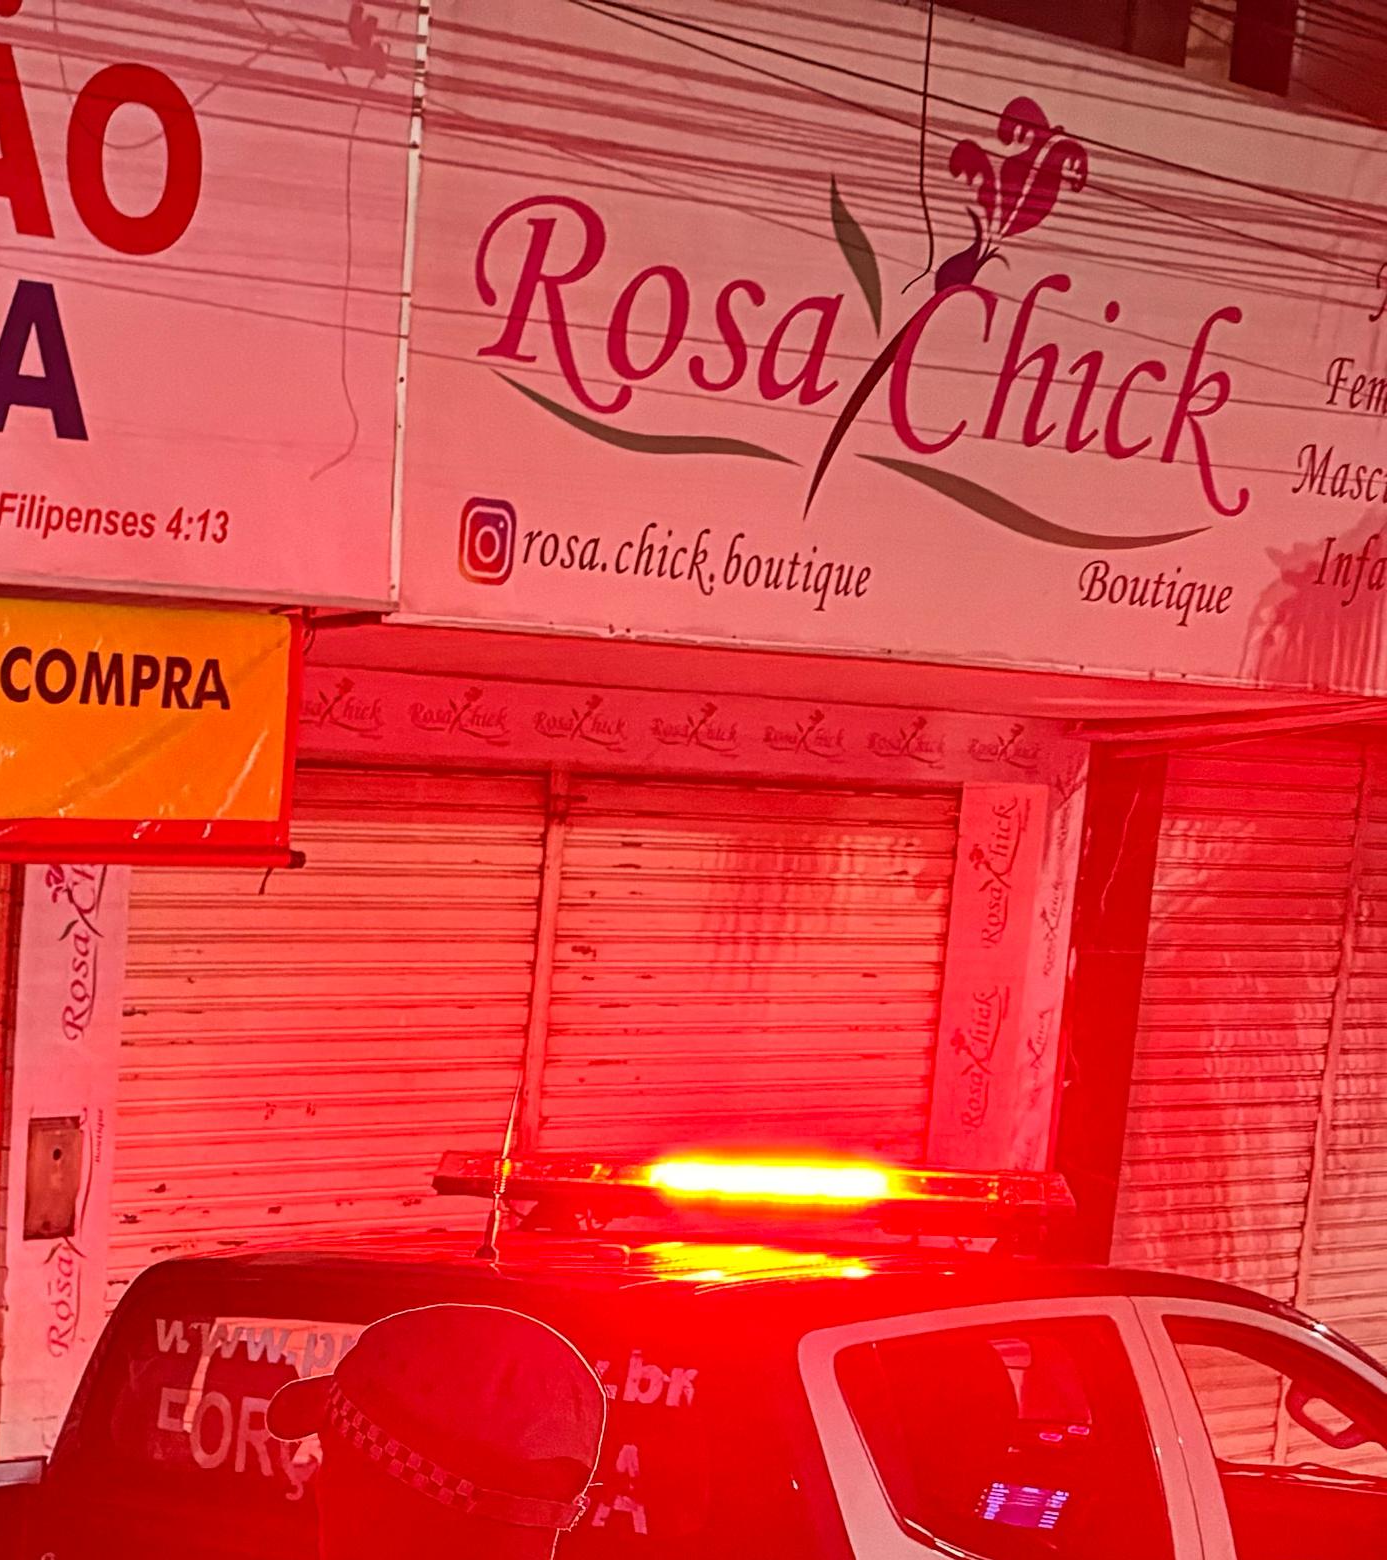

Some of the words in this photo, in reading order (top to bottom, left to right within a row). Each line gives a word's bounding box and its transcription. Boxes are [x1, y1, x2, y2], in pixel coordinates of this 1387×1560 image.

[475, 195, 845, 415] Rosa
[885, 272, 1251, 518] Chick
[165, 506, 230, 545] 4:13
[522, 522, 873, 613] rosa.chick.boutique
[1079, 559, 1234, 628] Boutique
[0, 646, 231, 711] COMPRA
[62, 930, 93, 1041] Rosa
[46, 1245, 75, 1358] Rosa
